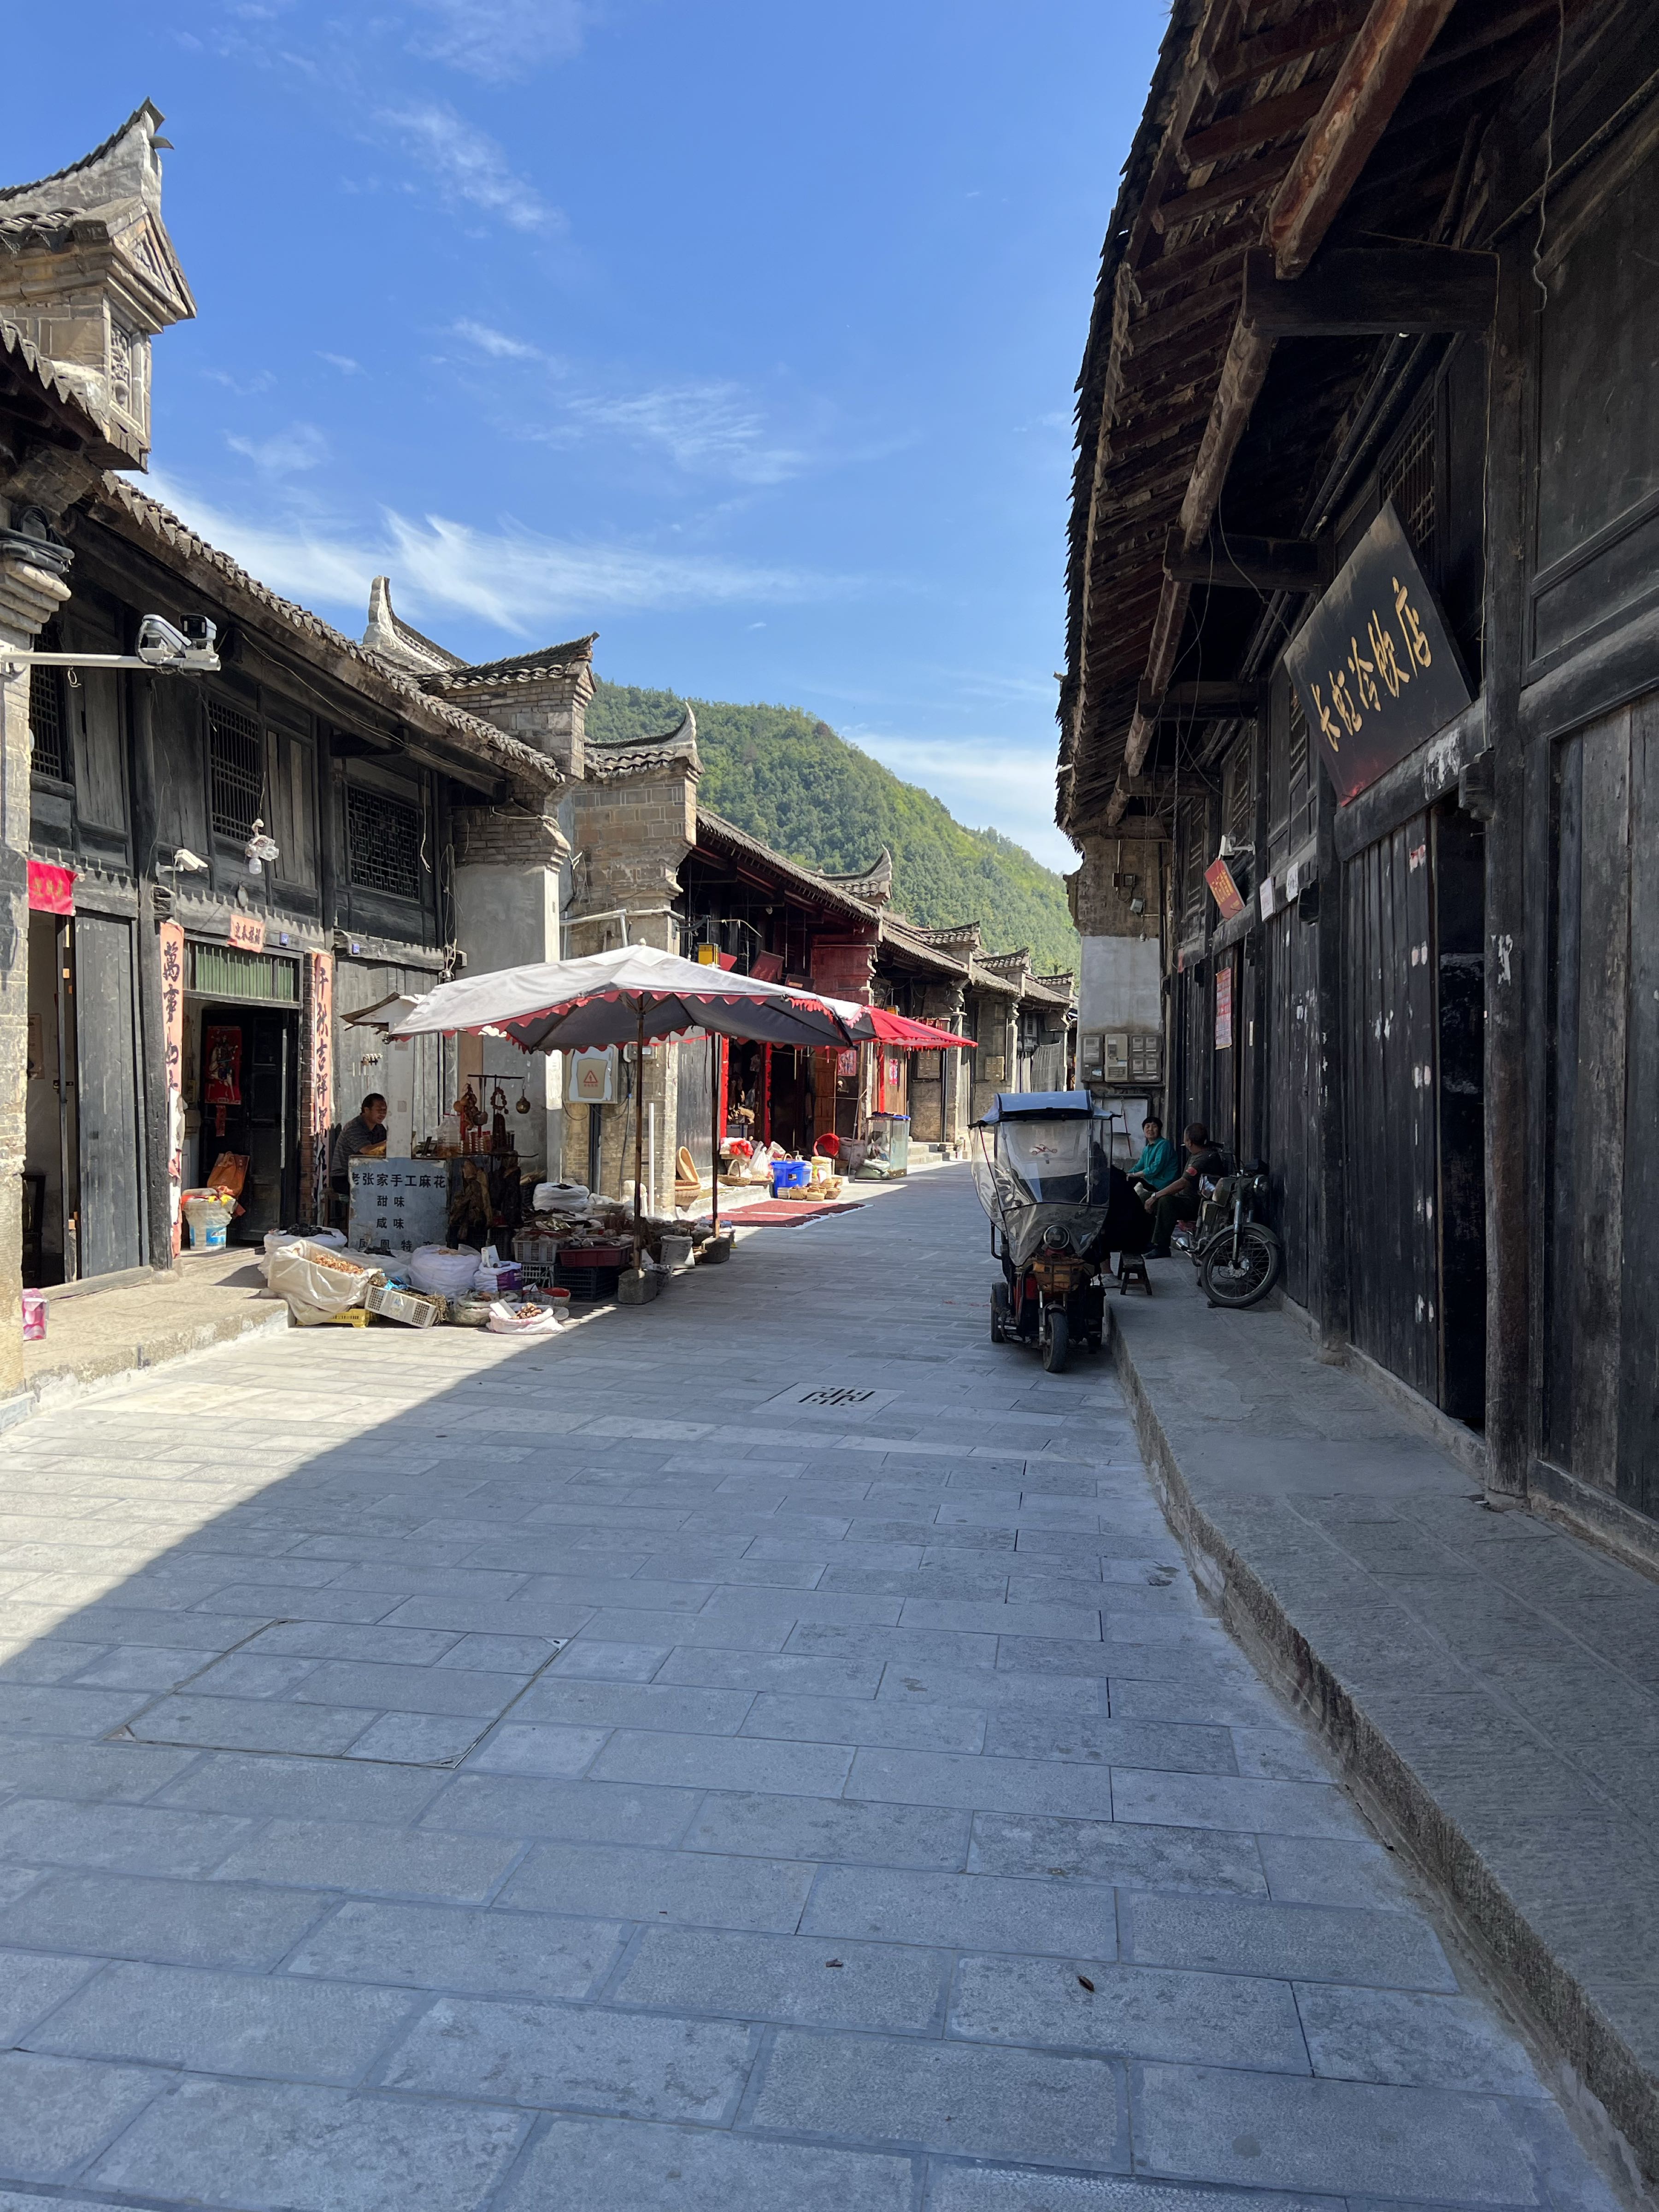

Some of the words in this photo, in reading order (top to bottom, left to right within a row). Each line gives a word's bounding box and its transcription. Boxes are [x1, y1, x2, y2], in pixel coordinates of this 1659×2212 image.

[352, 1172, 446, 1188] 老张家手工麻花
[377, 1195, 405, 1207] 甜味
[377, 1217, 404, 1229] 咸味
